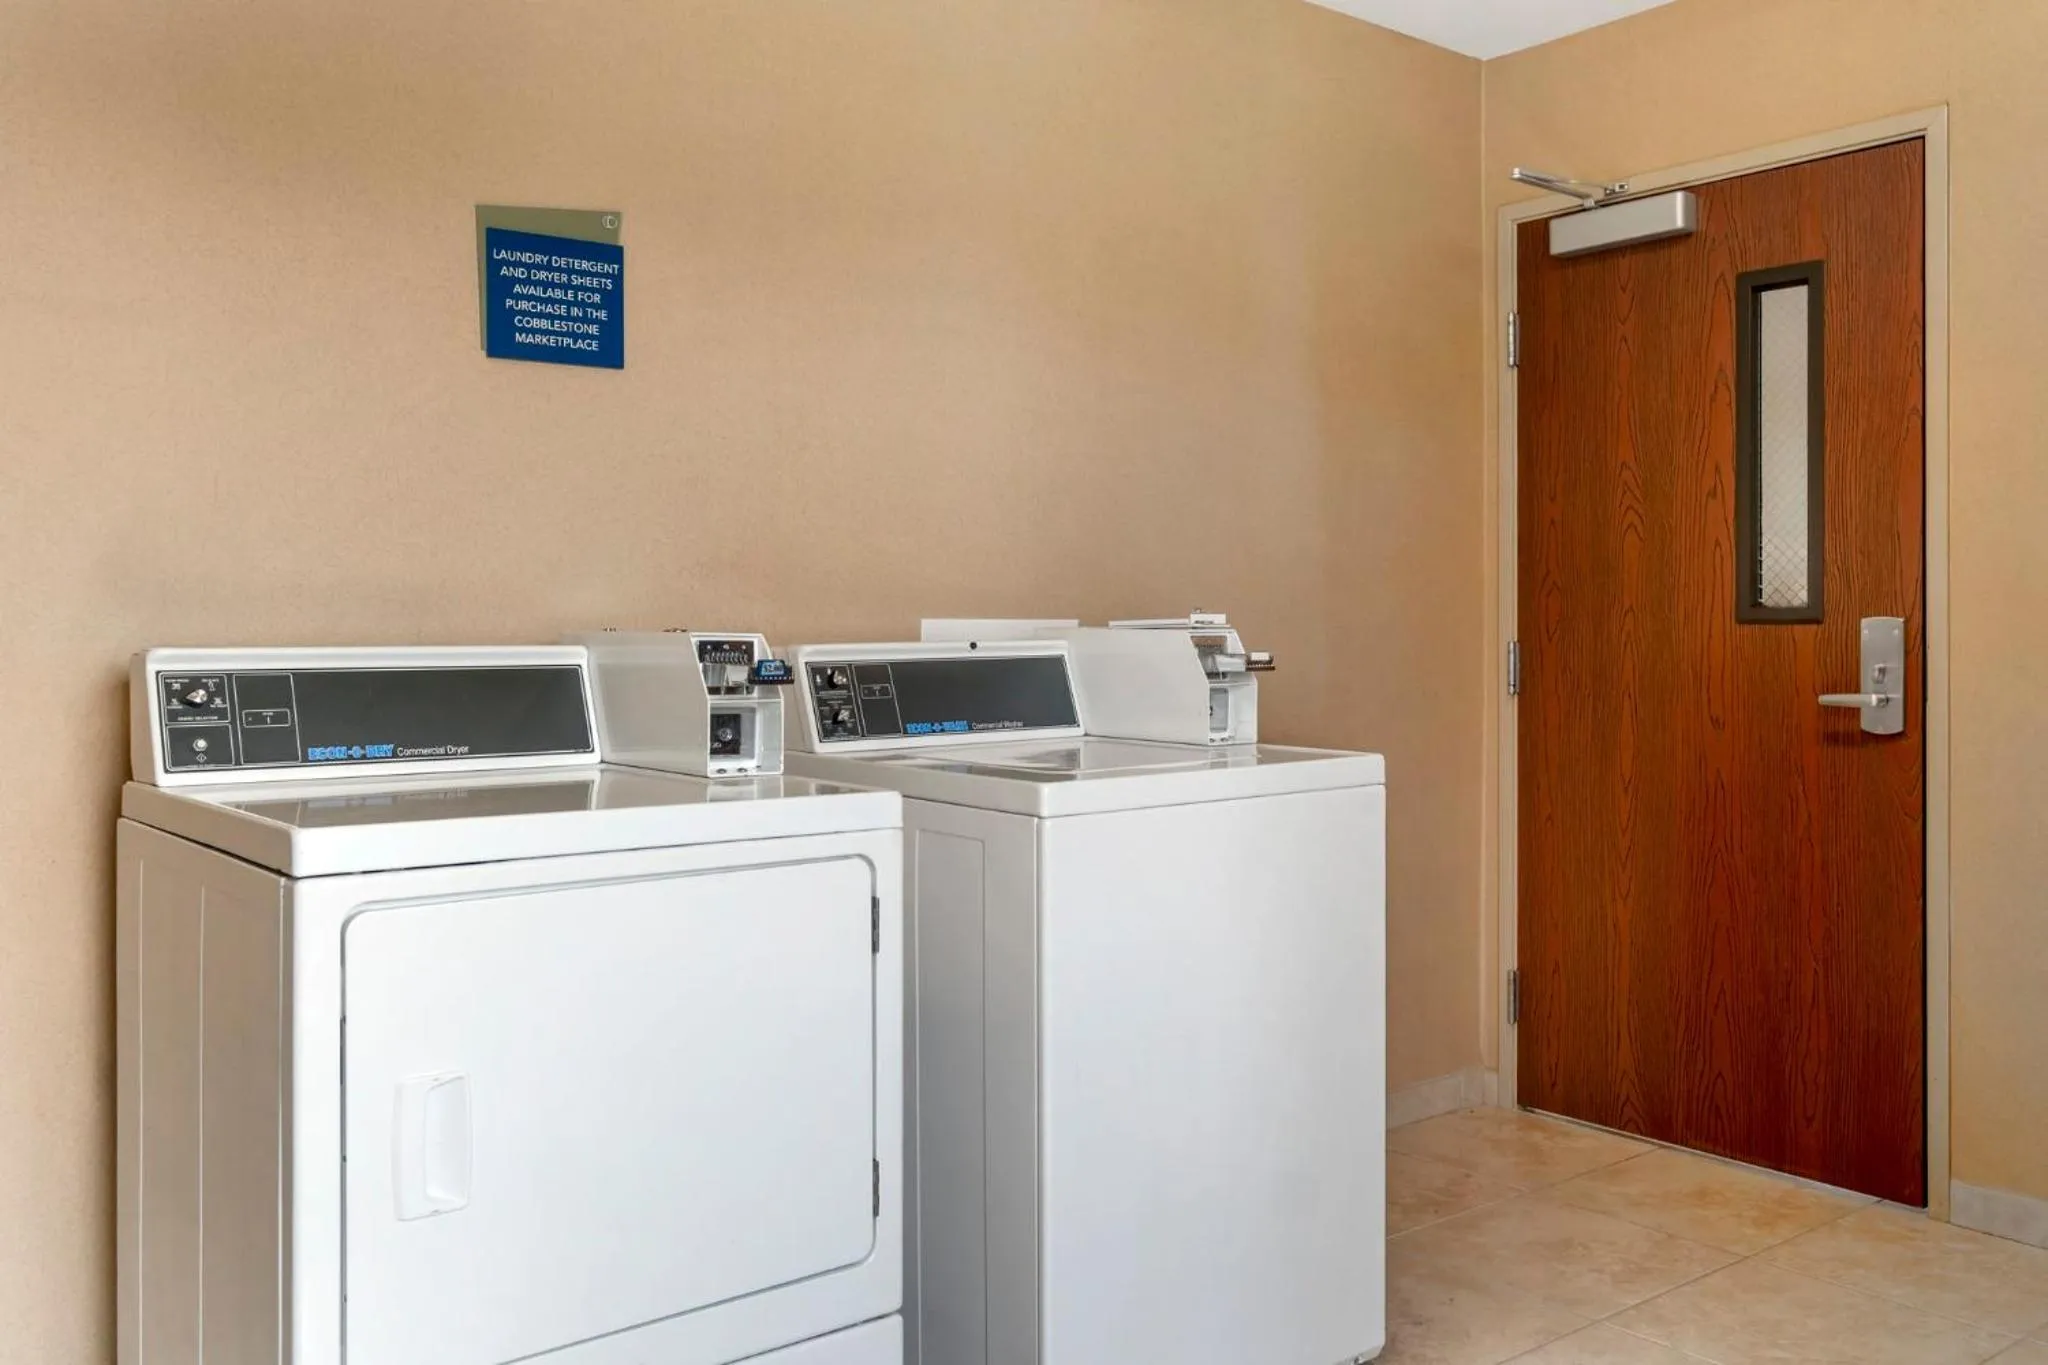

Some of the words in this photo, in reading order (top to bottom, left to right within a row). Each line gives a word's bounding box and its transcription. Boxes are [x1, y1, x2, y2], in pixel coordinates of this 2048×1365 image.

[493, 248, 550, 266] LAUNDRY
[551, 255, 620, 275] DETERGENT
[500, 266, 528, 278] AND
[530, 270, 568, 285] DRYER
[571, 275, 613, 290] SHEETS
[513, 283, 575, 301] AVAILABLE
[578, 291, 602, 304] FOR
[505, 299, 568, 316] PURCHASE
[570, 307, 583, 318] IN
[585, 308, 609, 321] THE
[514, 316, 600, 335] COBBLESTONE
[515, 332, 600, 351] MARKETPLACE
[396, 746, 446, 757] Commercial
[446, 745, 470, 757] Dryer
